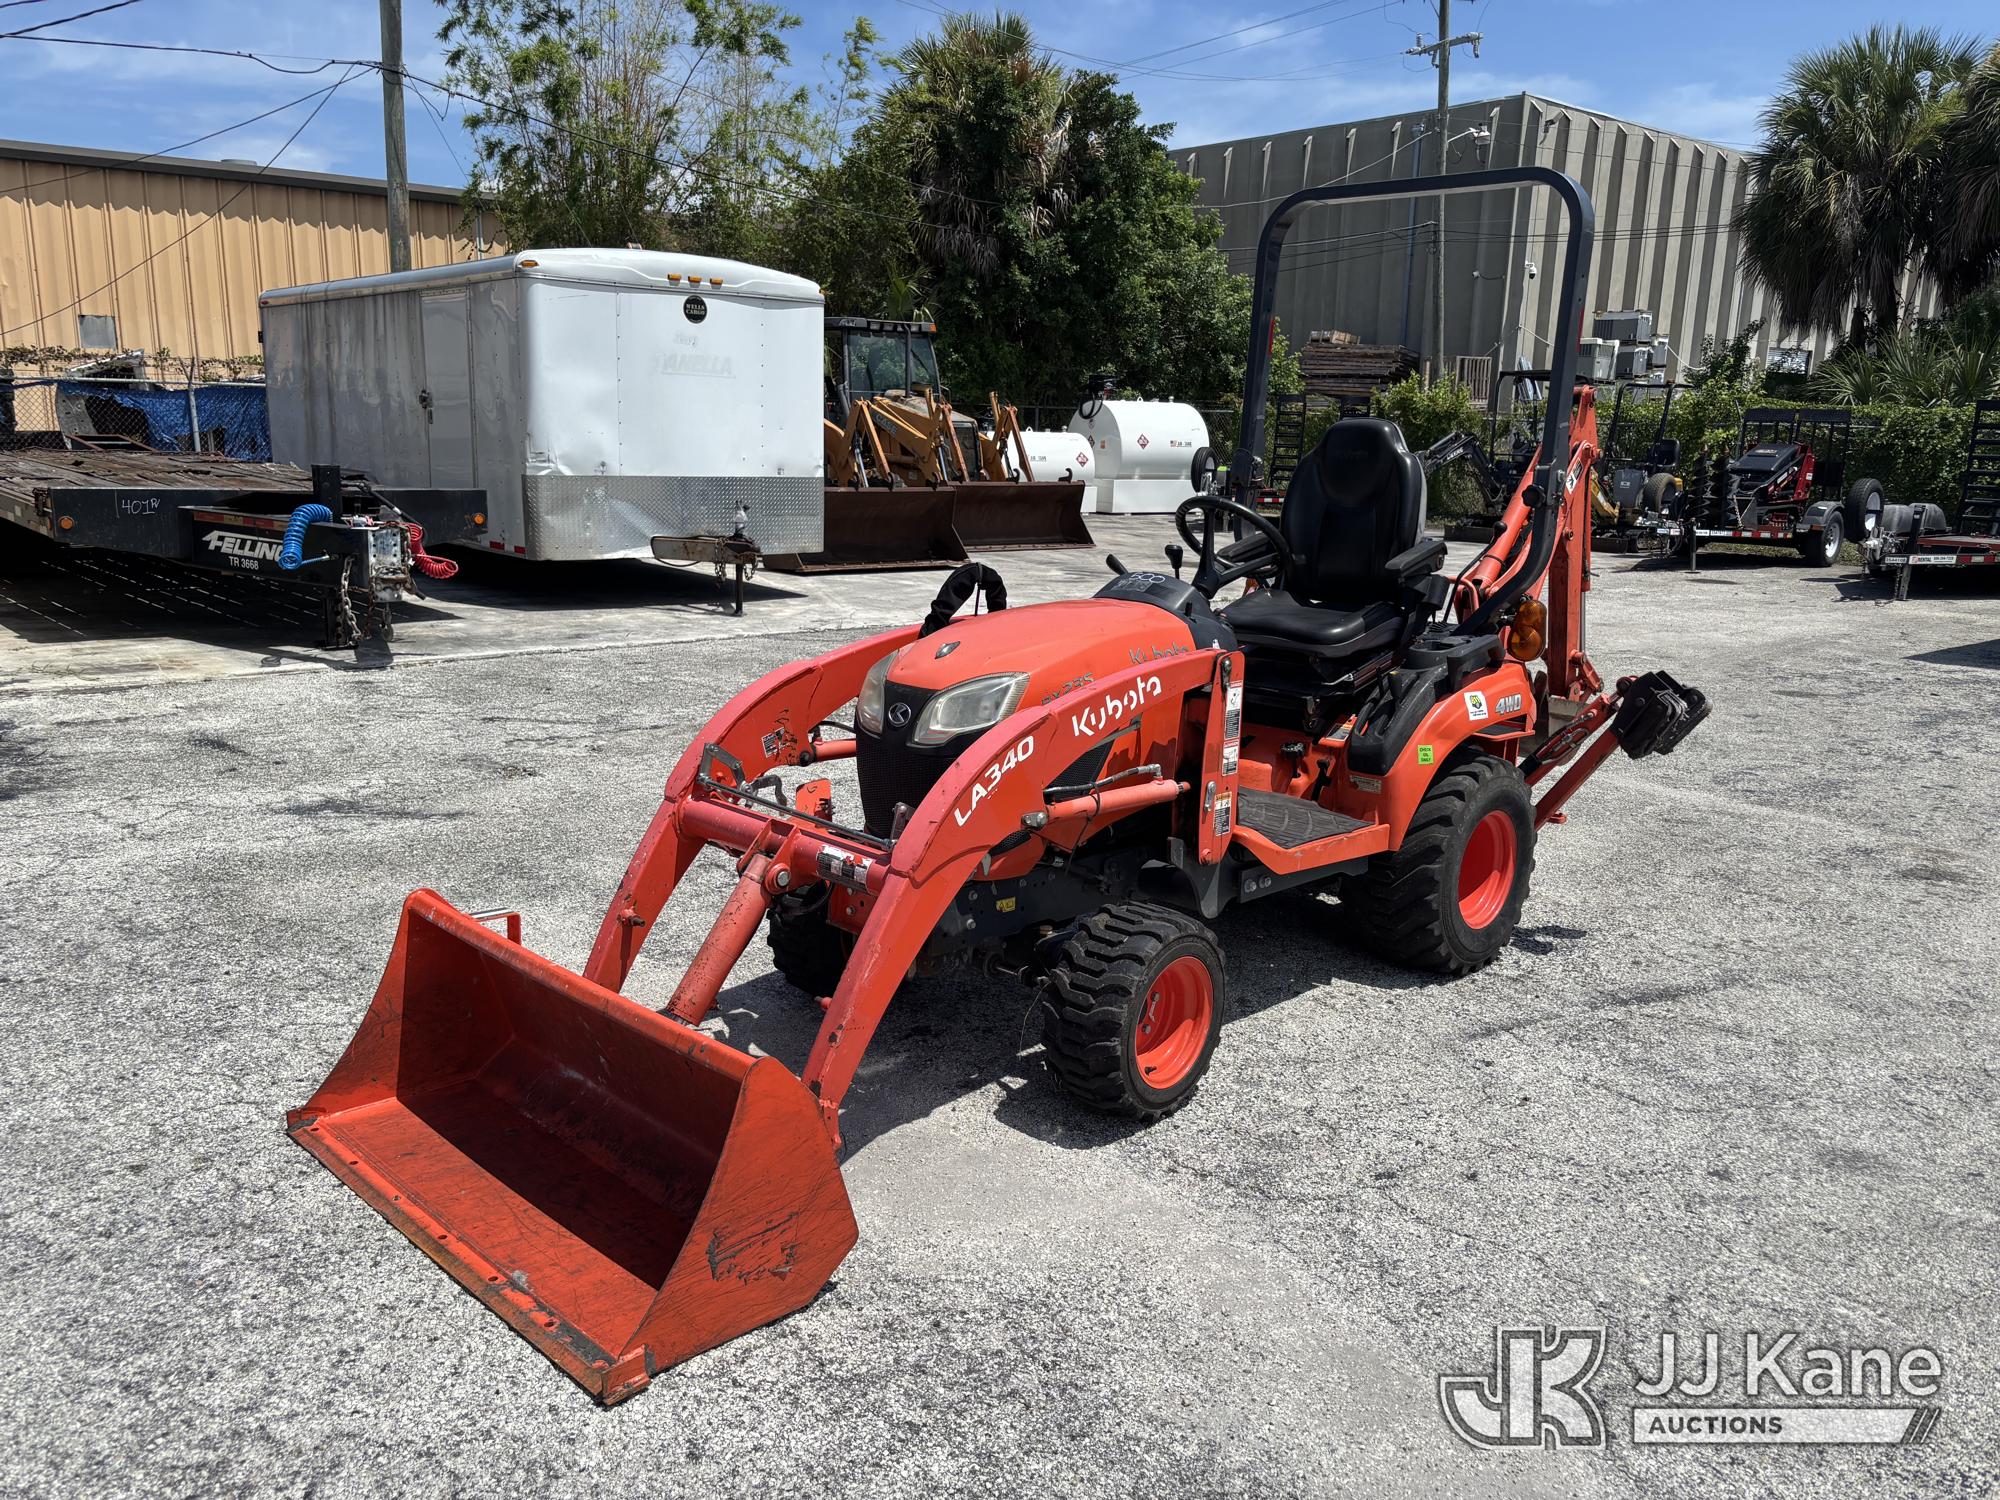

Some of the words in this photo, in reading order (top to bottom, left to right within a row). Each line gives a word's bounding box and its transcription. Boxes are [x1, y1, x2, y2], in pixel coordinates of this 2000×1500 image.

[229, 556, 240, 568] TR
[241, 558, 259, 570] 3668
[1071, 676, 1162, 737] Kubota
[1495, 694, 1522, 715] 4WD
[954, 735, 1034, 827] LA340
